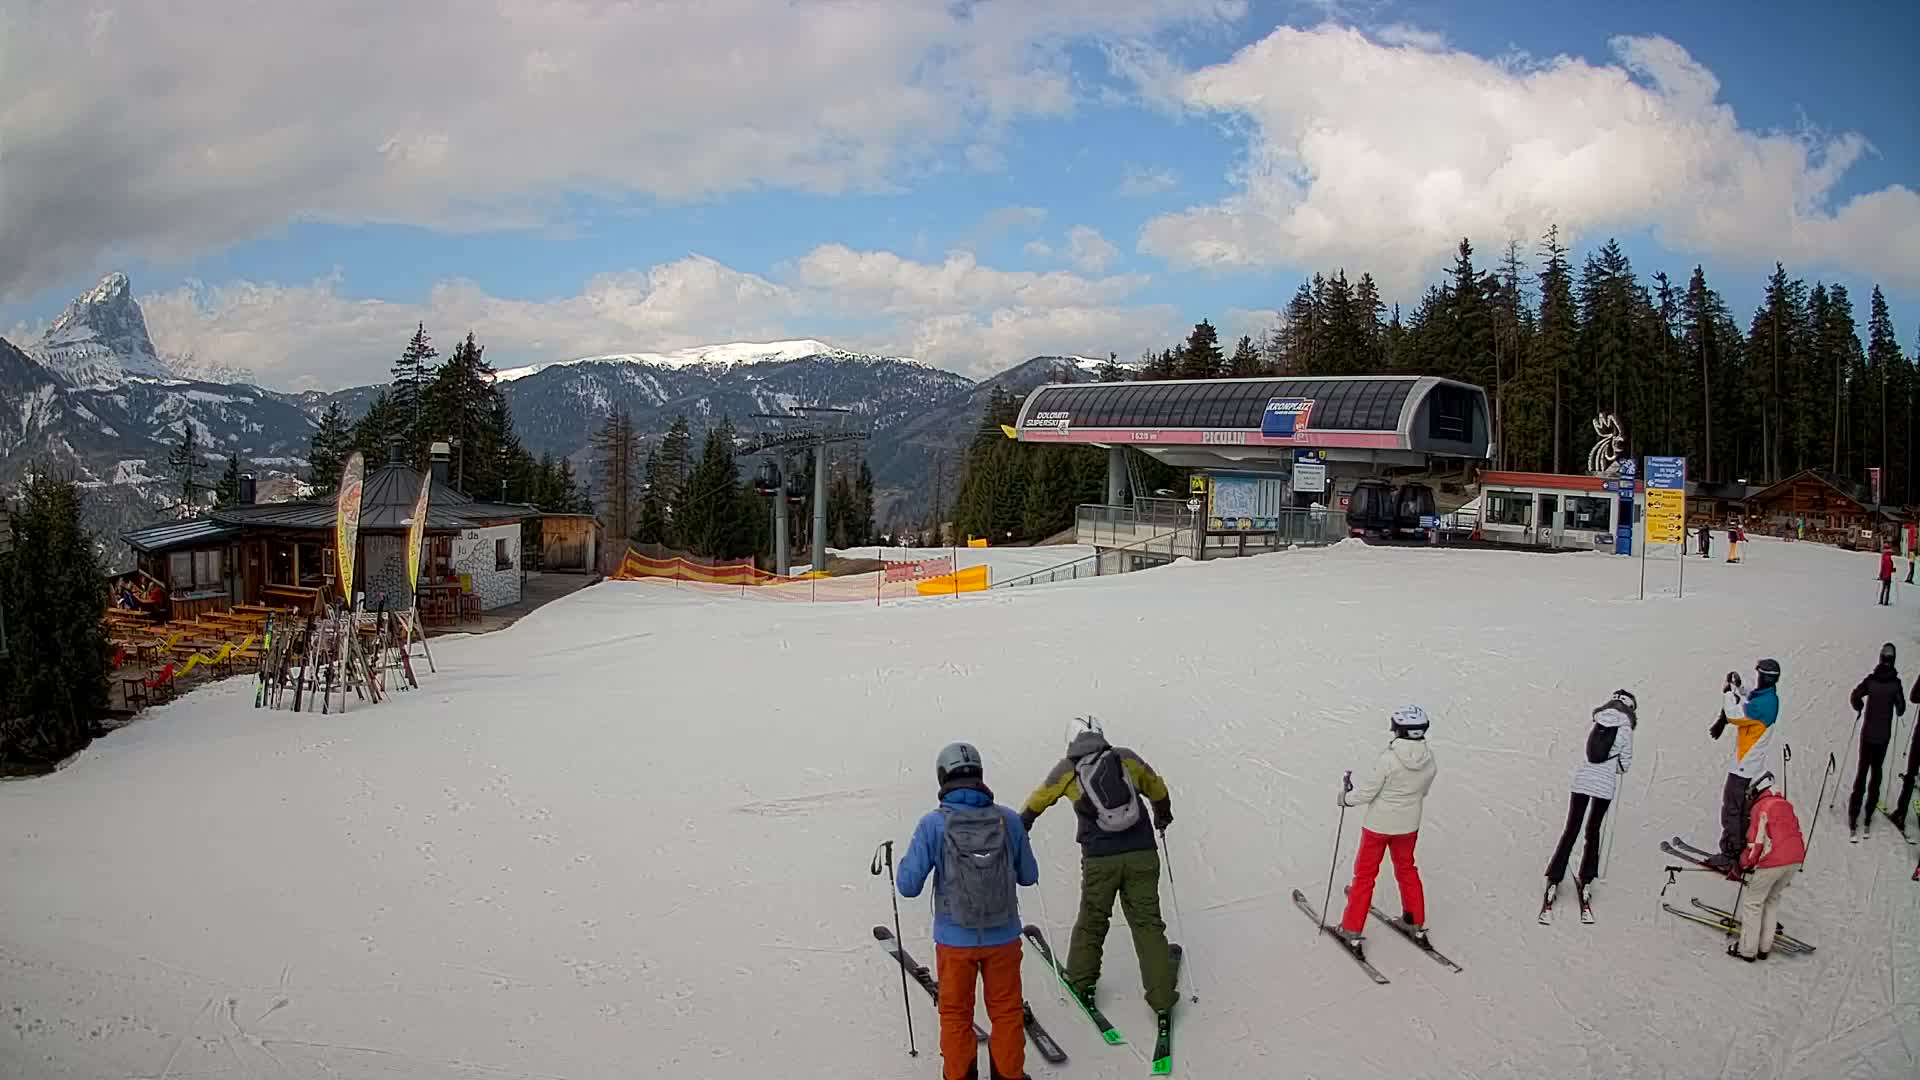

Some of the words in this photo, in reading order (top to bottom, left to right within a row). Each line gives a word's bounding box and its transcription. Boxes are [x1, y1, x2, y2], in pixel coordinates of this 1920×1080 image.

[1267, 402, 1313, 411] KRONPLATZ
[1037, 411, 1069, 419] DOLOMITI
[1025, 419, 1059, 427] SUPERSKI
[1202, 431, 1246, 444] PICULIN
[467, 531, 479, 540] da
